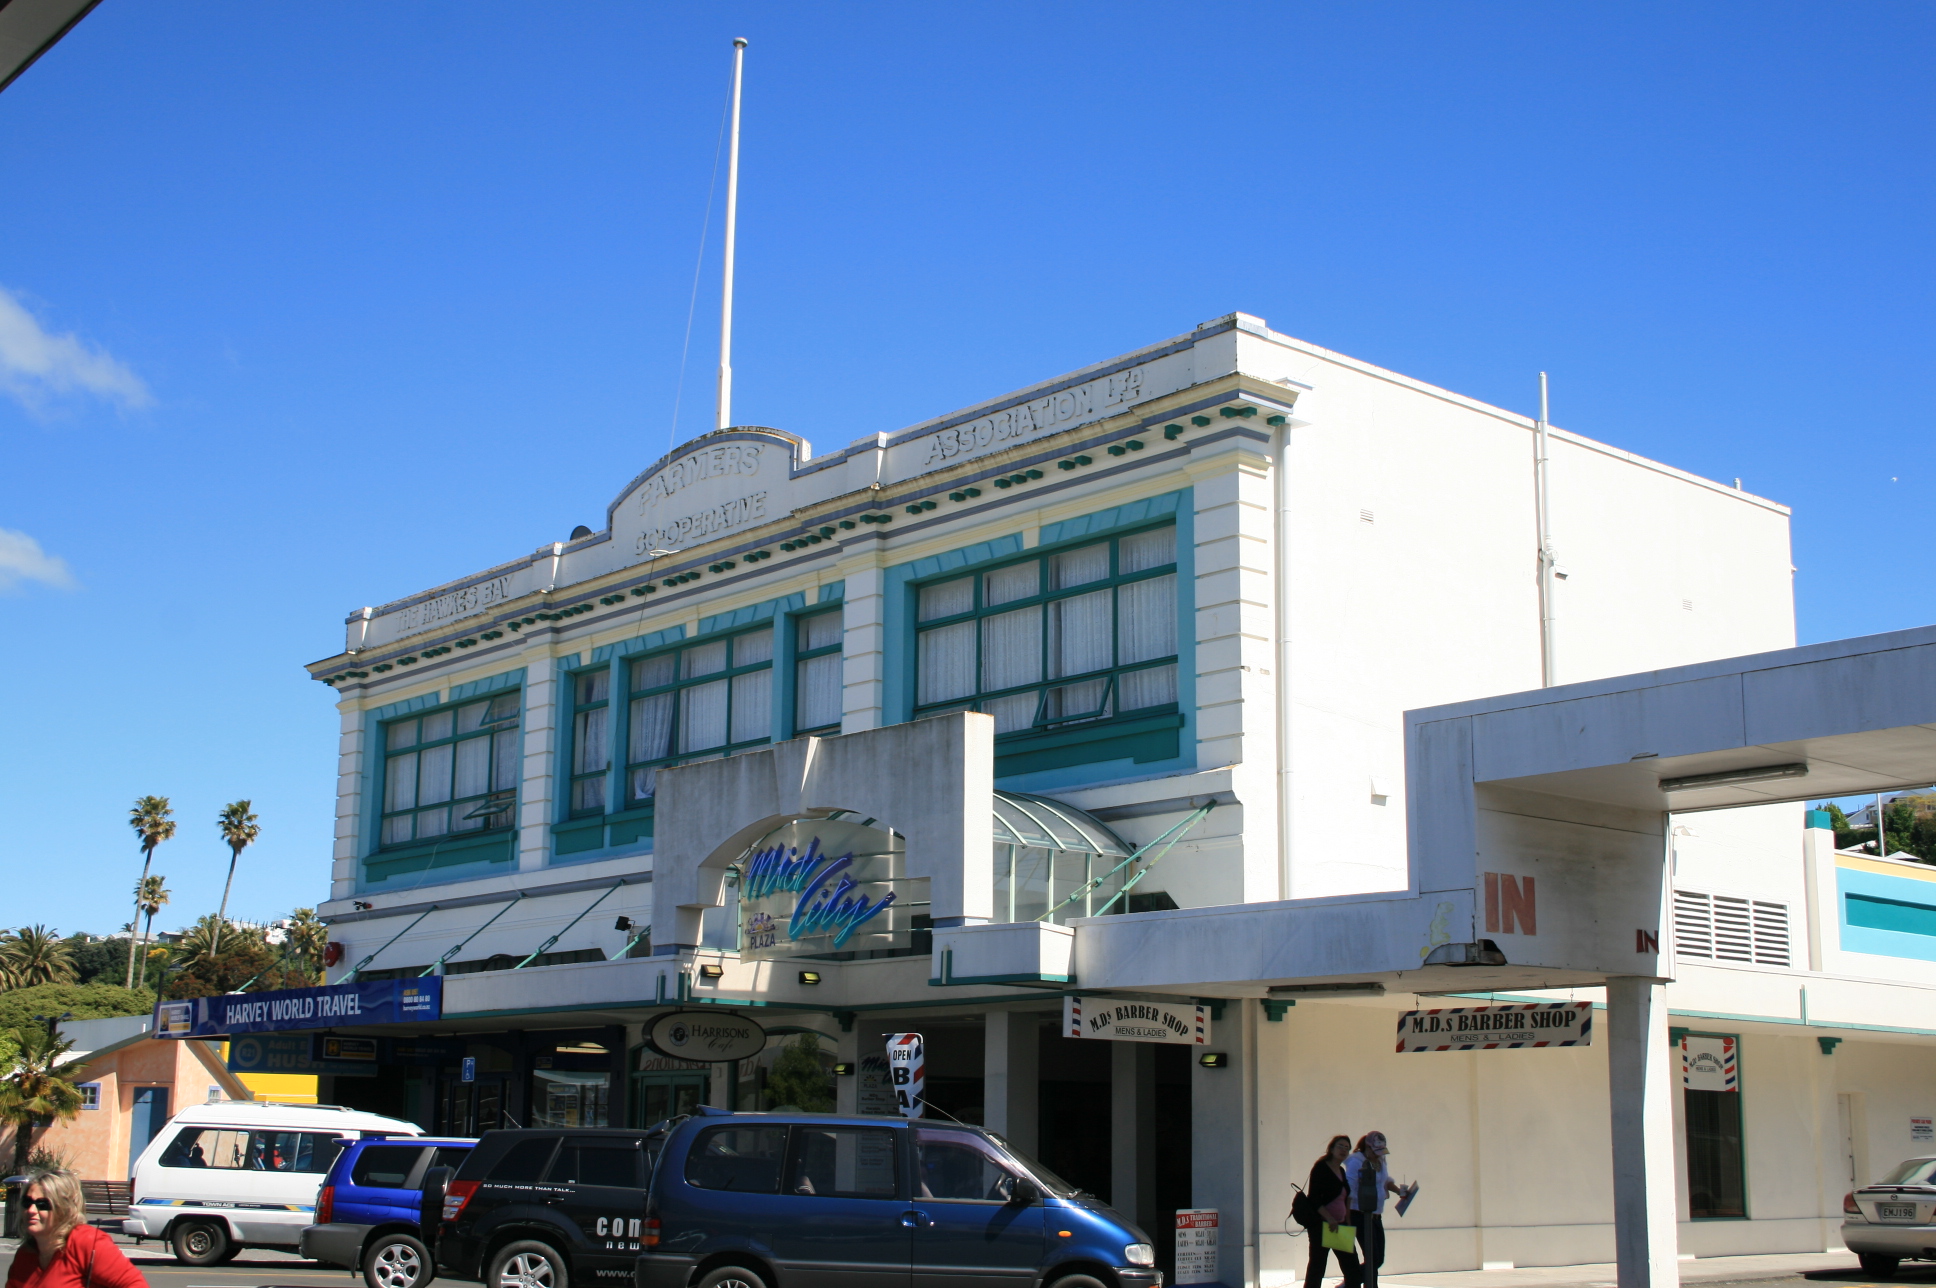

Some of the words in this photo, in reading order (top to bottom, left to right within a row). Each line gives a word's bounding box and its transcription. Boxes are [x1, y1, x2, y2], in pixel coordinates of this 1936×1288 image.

[925, 384, 1093, 465] ASSOCIATION
[396, 606, 419, 633] THE
[482, 574, 514, 605] BAY
[743, 836, 825, 901] Mid
[788, 851, 897, 950] City
[1484, 872, 1537, 936] IN
[750, 933, 776, 950] PLAZA
[1636, 929, 1660, 954] IN
[226, 1001, 270, 1024] HARVEY
[272, 997, 314, 1020] WORLD
[317, 994, 362, 1017] TRAVEL
[692, 1025, 749, 1038] HARRISONS
[1115, 1005, 1159, 1022] BARBER
[1162, 1012, 1189, 1036] SHOP
[1412, 1016, 1453, 1033] M.D.s
[1457, 1012, 1525, 1032] BARBER
[1530, 1010, 1576, 1028] SHOP
[1116, 1028, 1135, 1036] MENS
[1143, 1028, 1167, 1037] LADIES
[268, 1040, 295, 1050] Adult
[893, 1050, 912, 1060] OPEN
[1697, 1052, 1712, 1061] BARBER
[1713, 1056, 1724, 1070] SHOP
[1883, 1208, 1913, 1217] EMJ196
[596, 1216, 641, 1237] com
[596, 1270, 636, 1278] www.c
